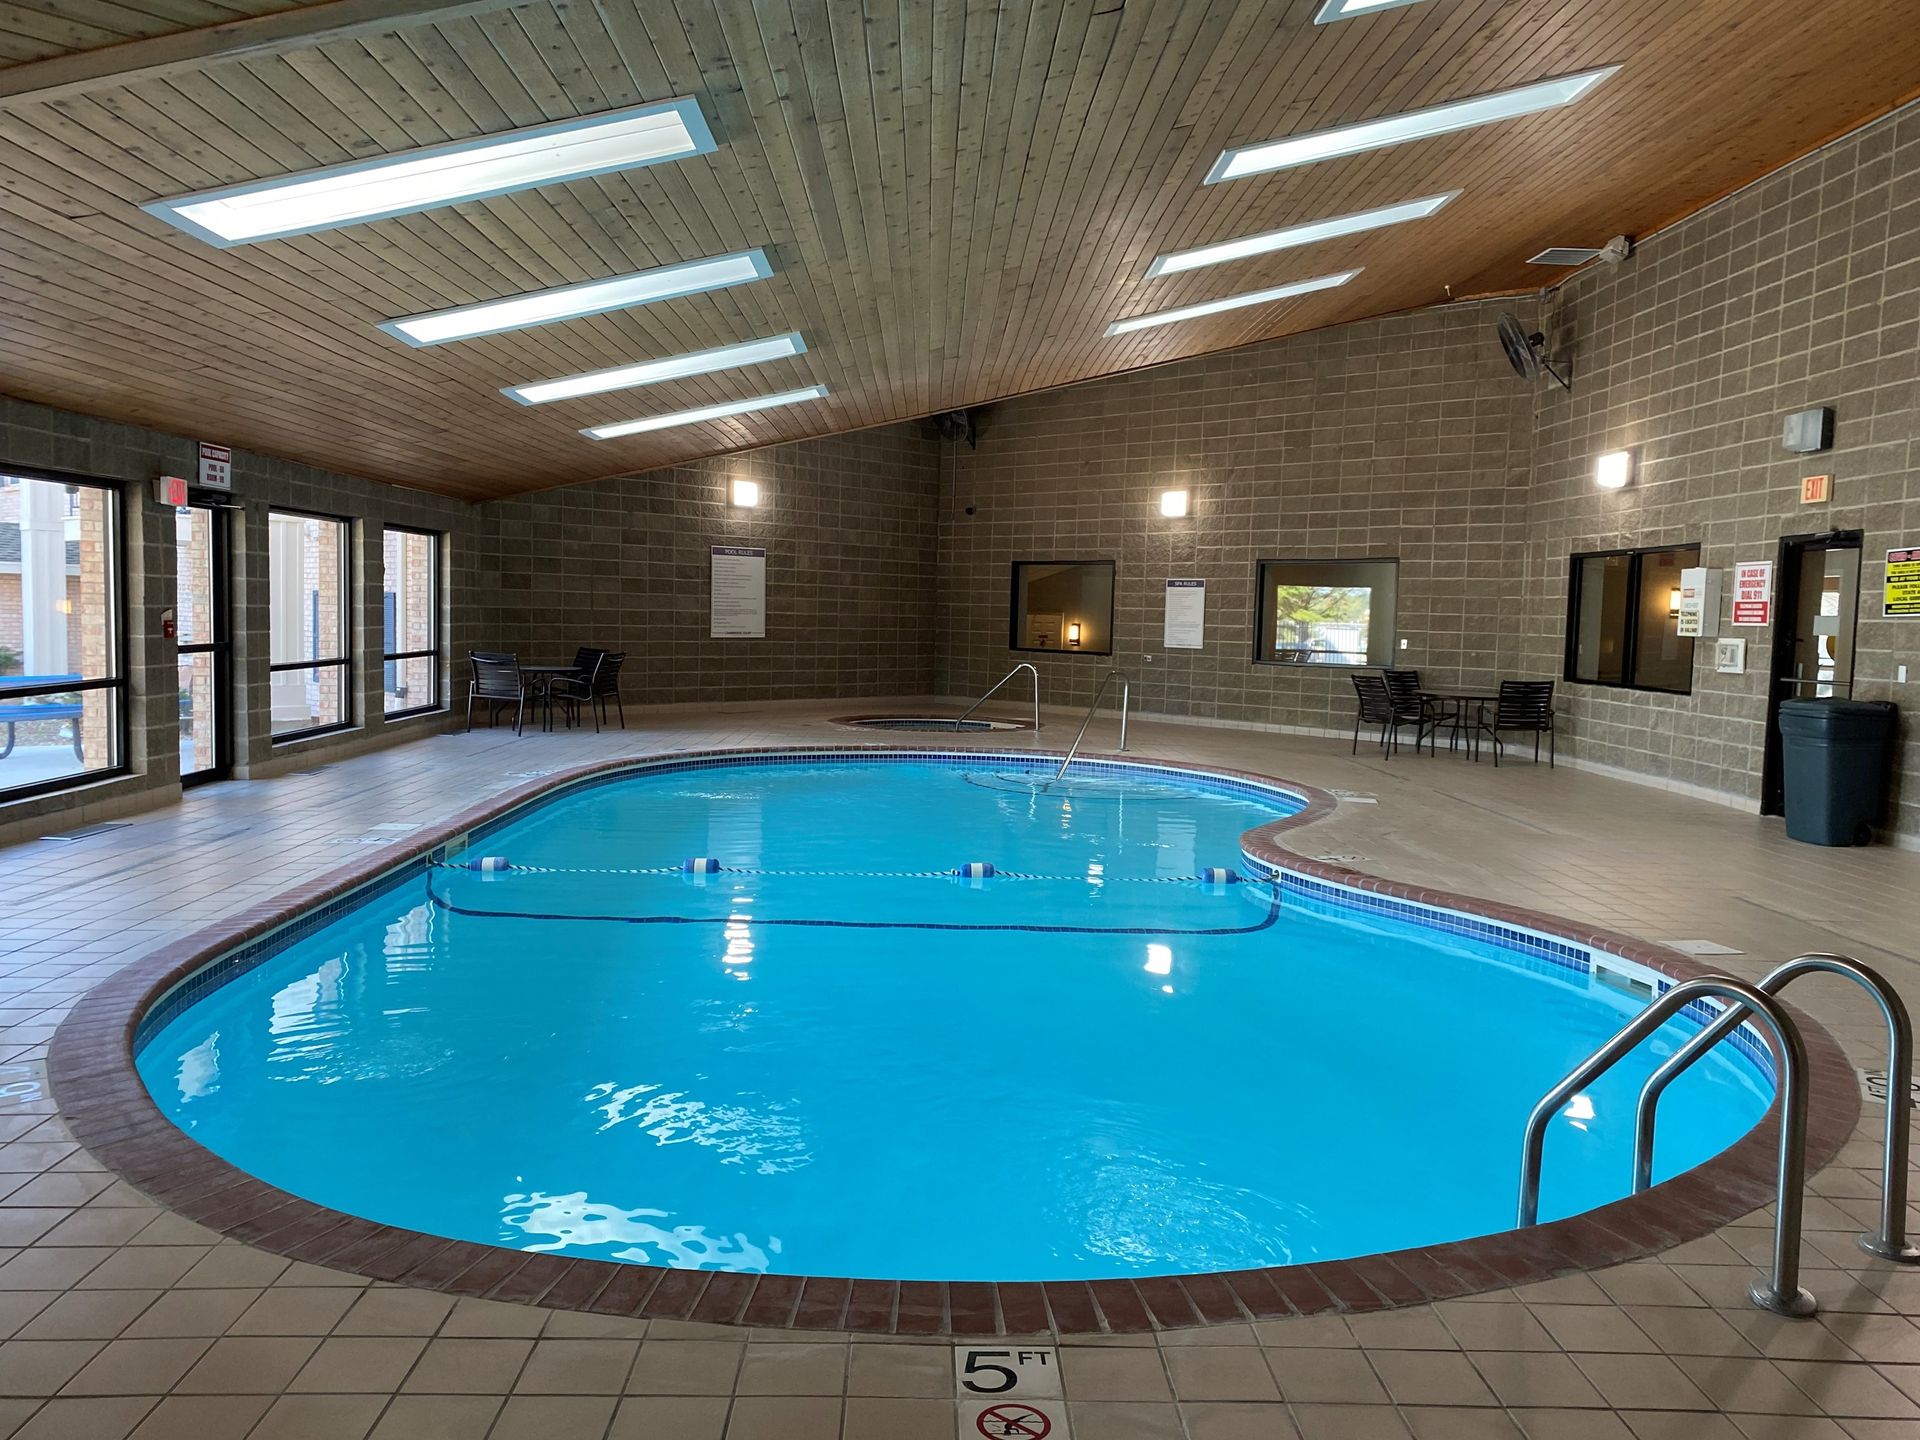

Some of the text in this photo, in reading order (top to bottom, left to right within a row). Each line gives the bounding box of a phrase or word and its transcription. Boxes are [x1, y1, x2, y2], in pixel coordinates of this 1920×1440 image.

[169, 479, 186, 506] EXIT
[1804, 477, 1825, 500] EXIT
[1741, 568, 1766, 578] IN CASE OF
[1739, 579, 1766, 588] EMERGENCY
[1741, 590, 1763, 600] DIAL 911
[961, 1350, 1051, 1394] 5 FT
